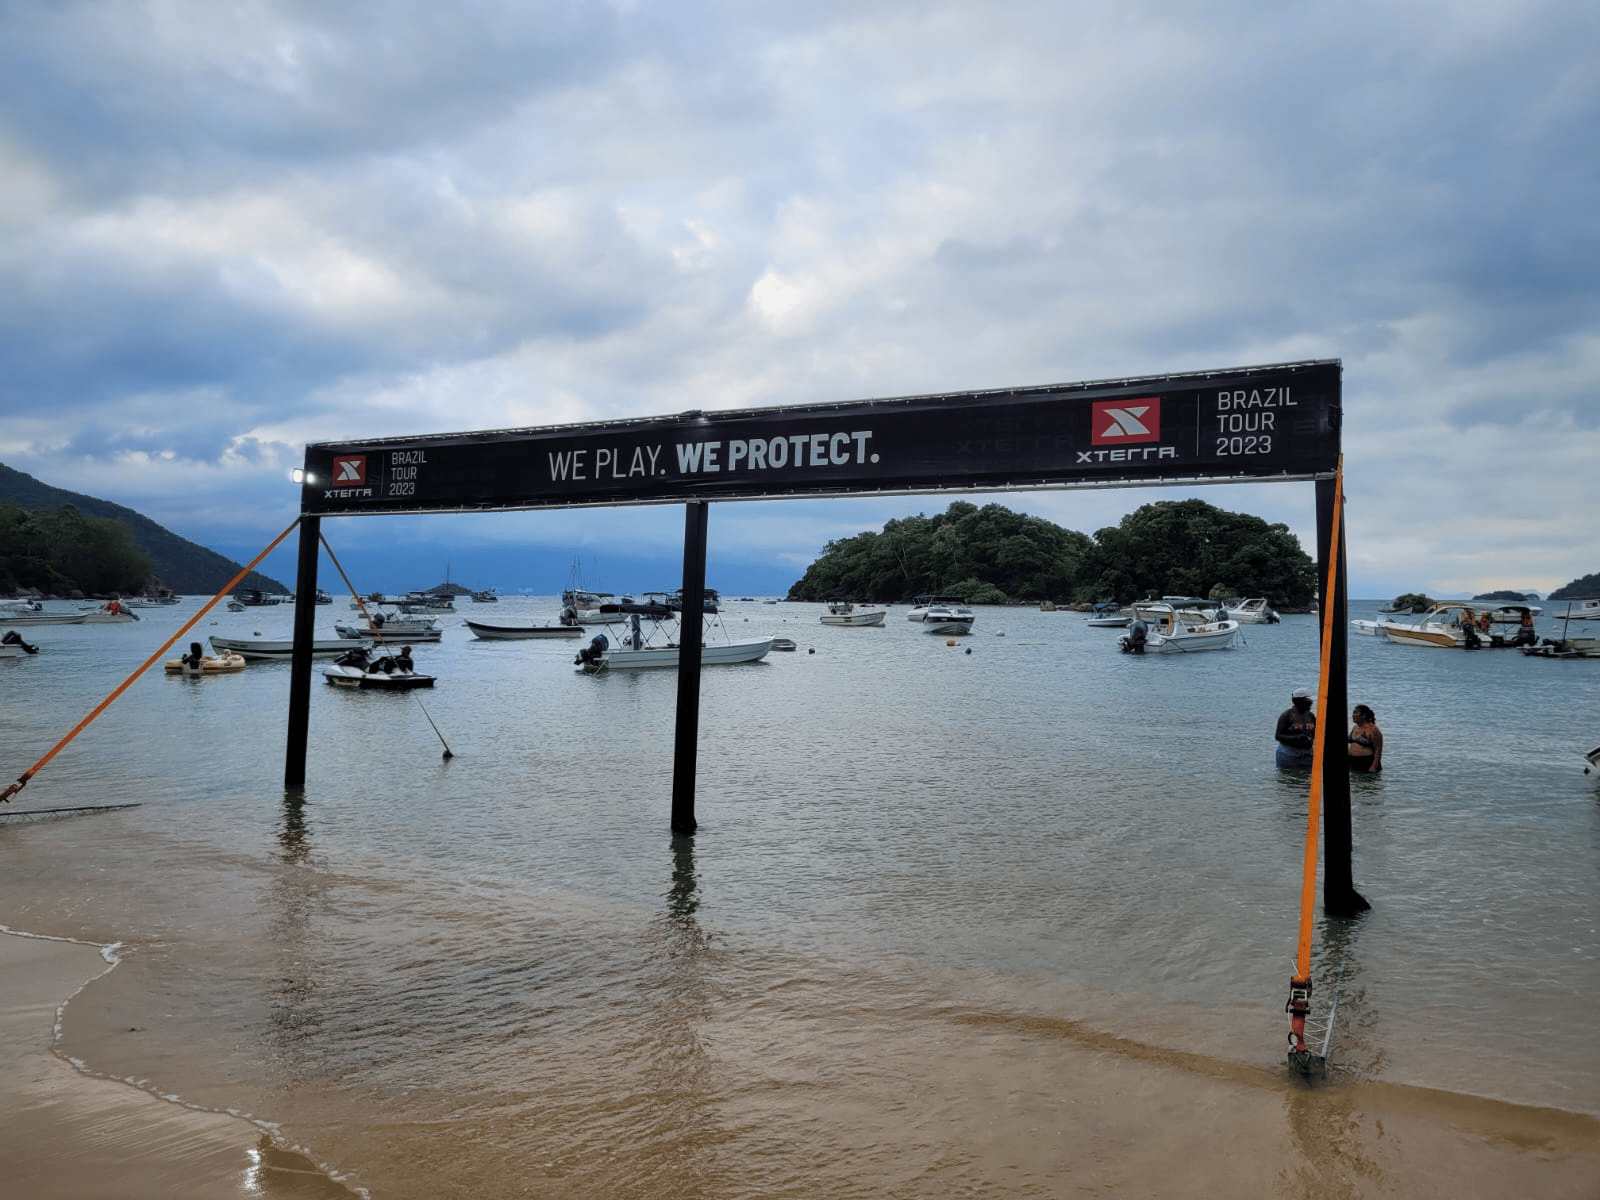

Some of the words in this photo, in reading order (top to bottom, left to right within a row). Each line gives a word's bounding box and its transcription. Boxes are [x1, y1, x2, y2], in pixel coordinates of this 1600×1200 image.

[1218, 386, 1298, 411] BRAZIL
[1216, 411, 1275, 433] TOUR
[548, 449, 588, 481] WE
[595, 444, 666, 479] PLAY.
[675, 441, 721, 474] WE
[728, 430, 880, 471] PROTECT.
[1216, 435, 1272, 456] 2023
[391, 450, 428, 465] BRAZIL
[391, 466, 417, 480] TOUR
[389, 482, 415, 496] 2023
